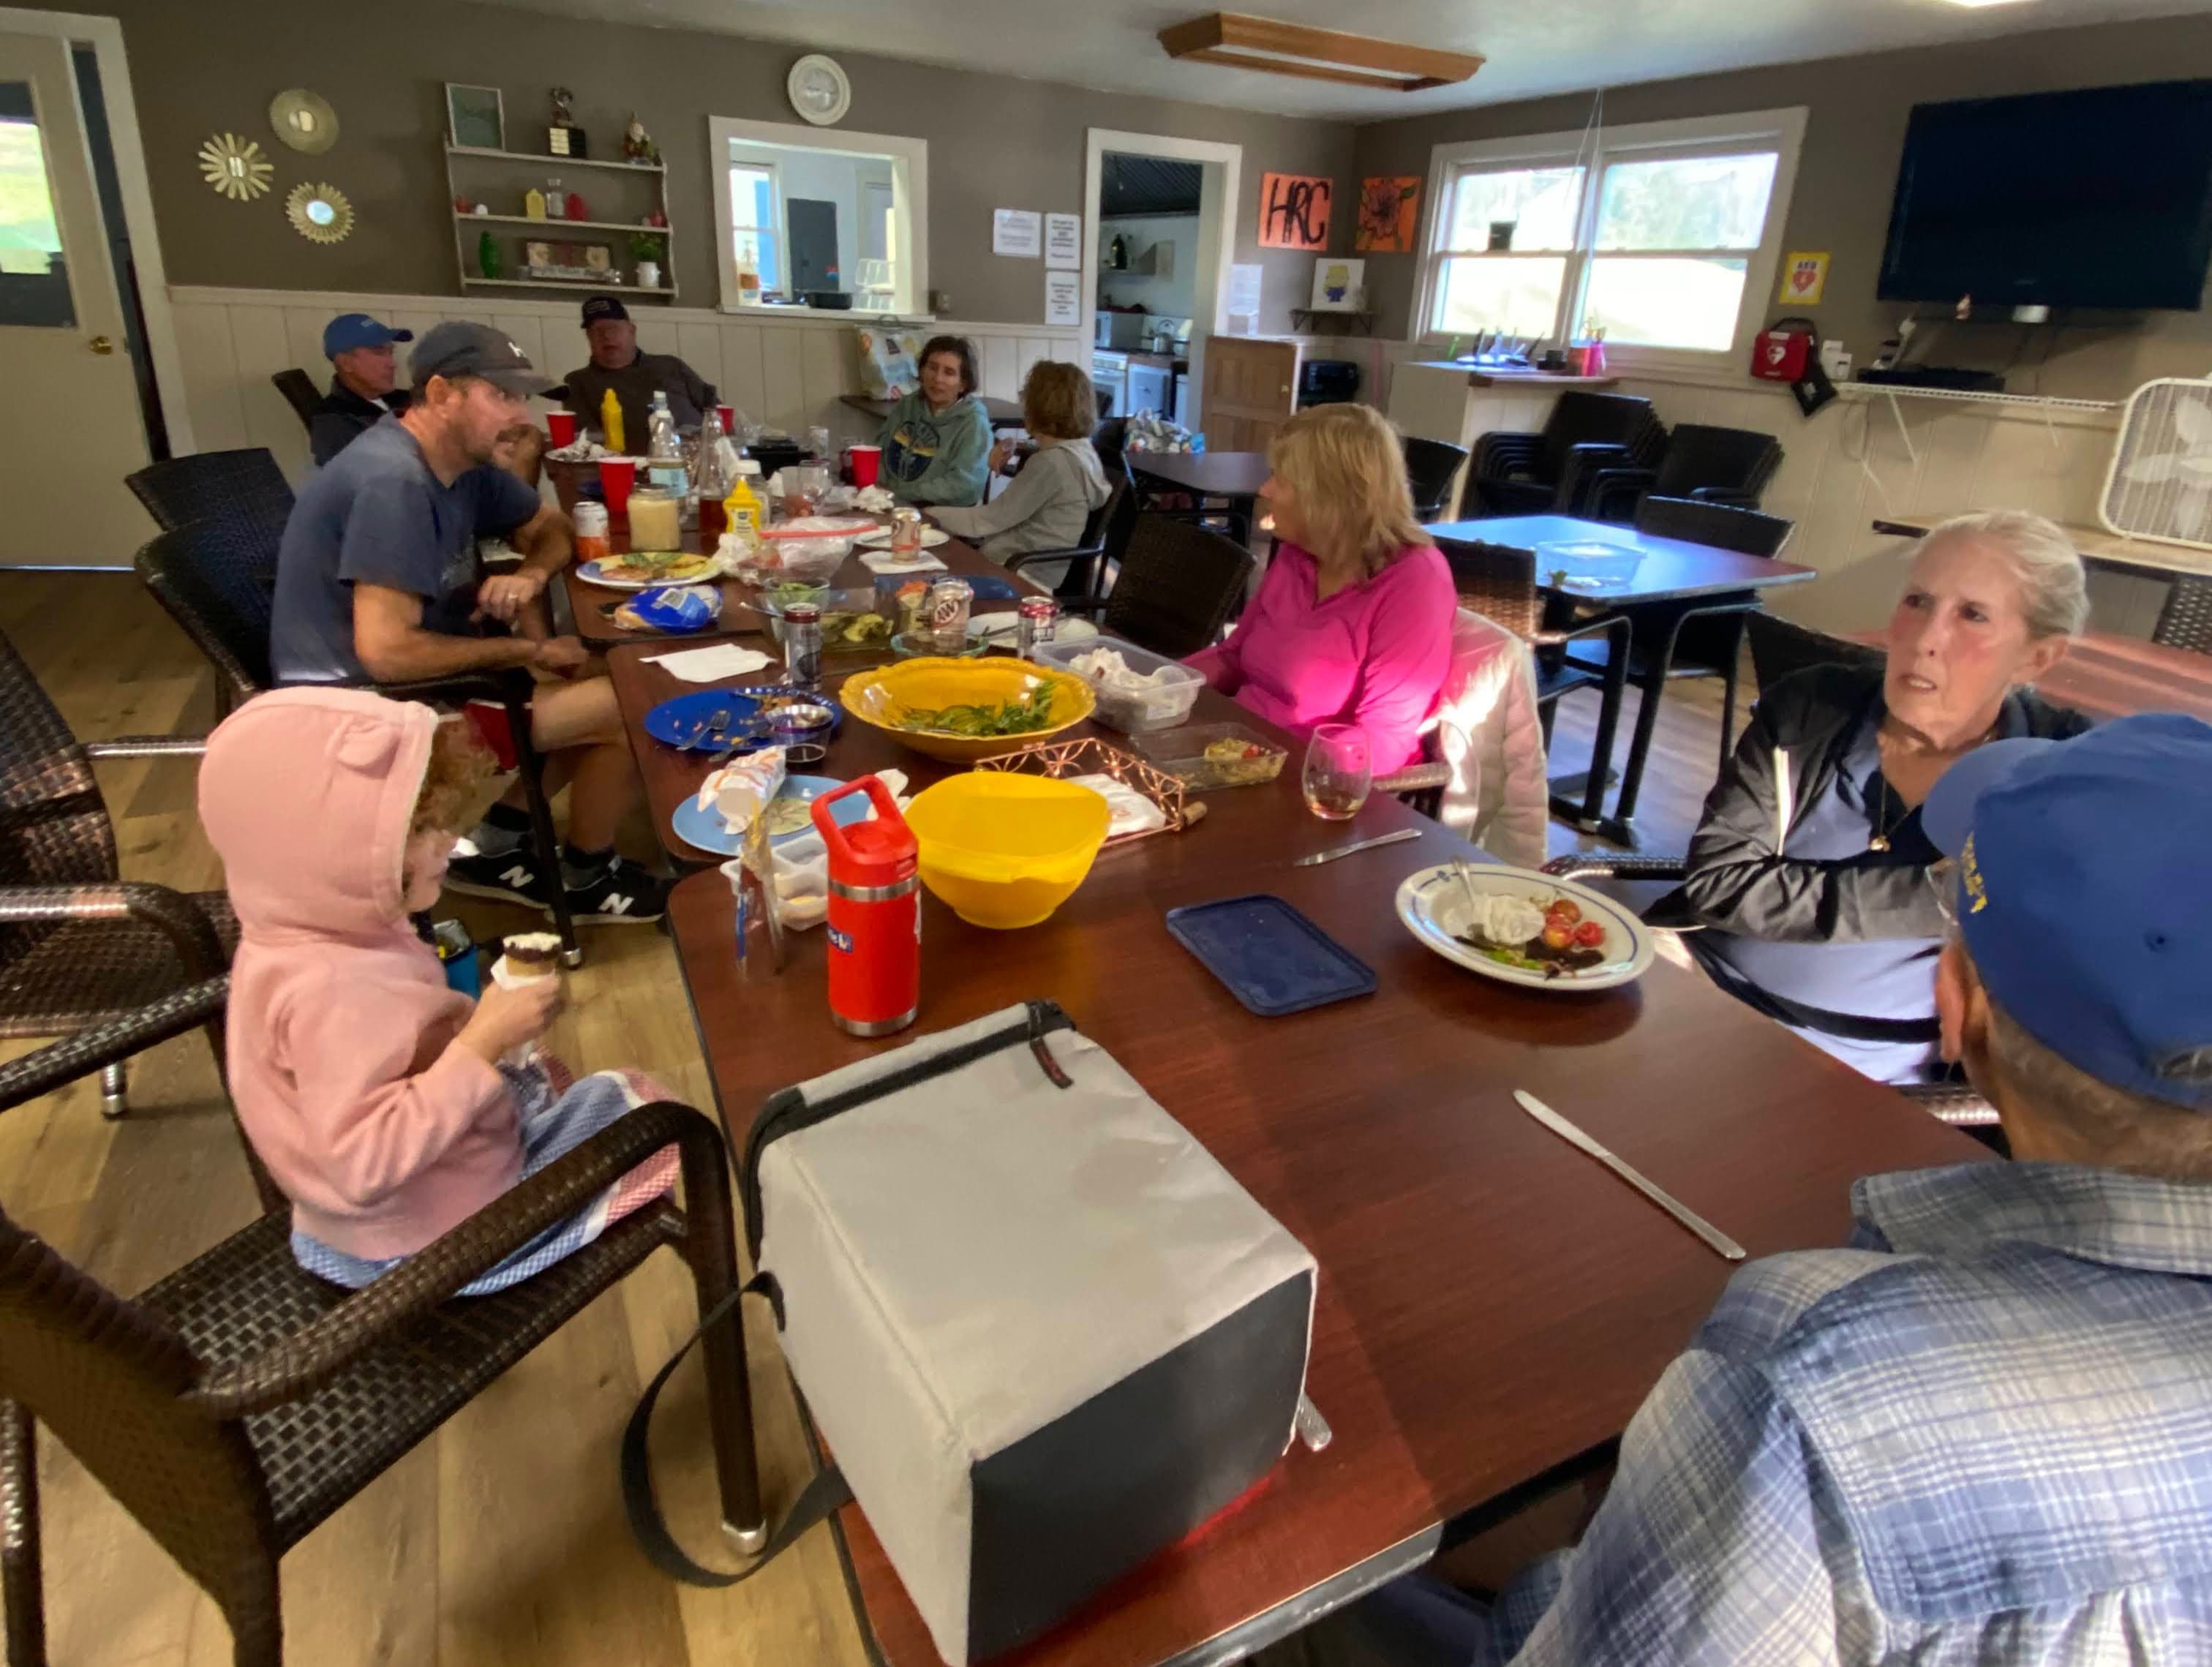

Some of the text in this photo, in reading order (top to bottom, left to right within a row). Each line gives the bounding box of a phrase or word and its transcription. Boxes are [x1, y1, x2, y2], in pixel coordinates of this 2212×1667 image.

[1265, 178, 1329, 244] HRC
[499, 865, 535, 888] N
[598, 892, 635, 914] N
